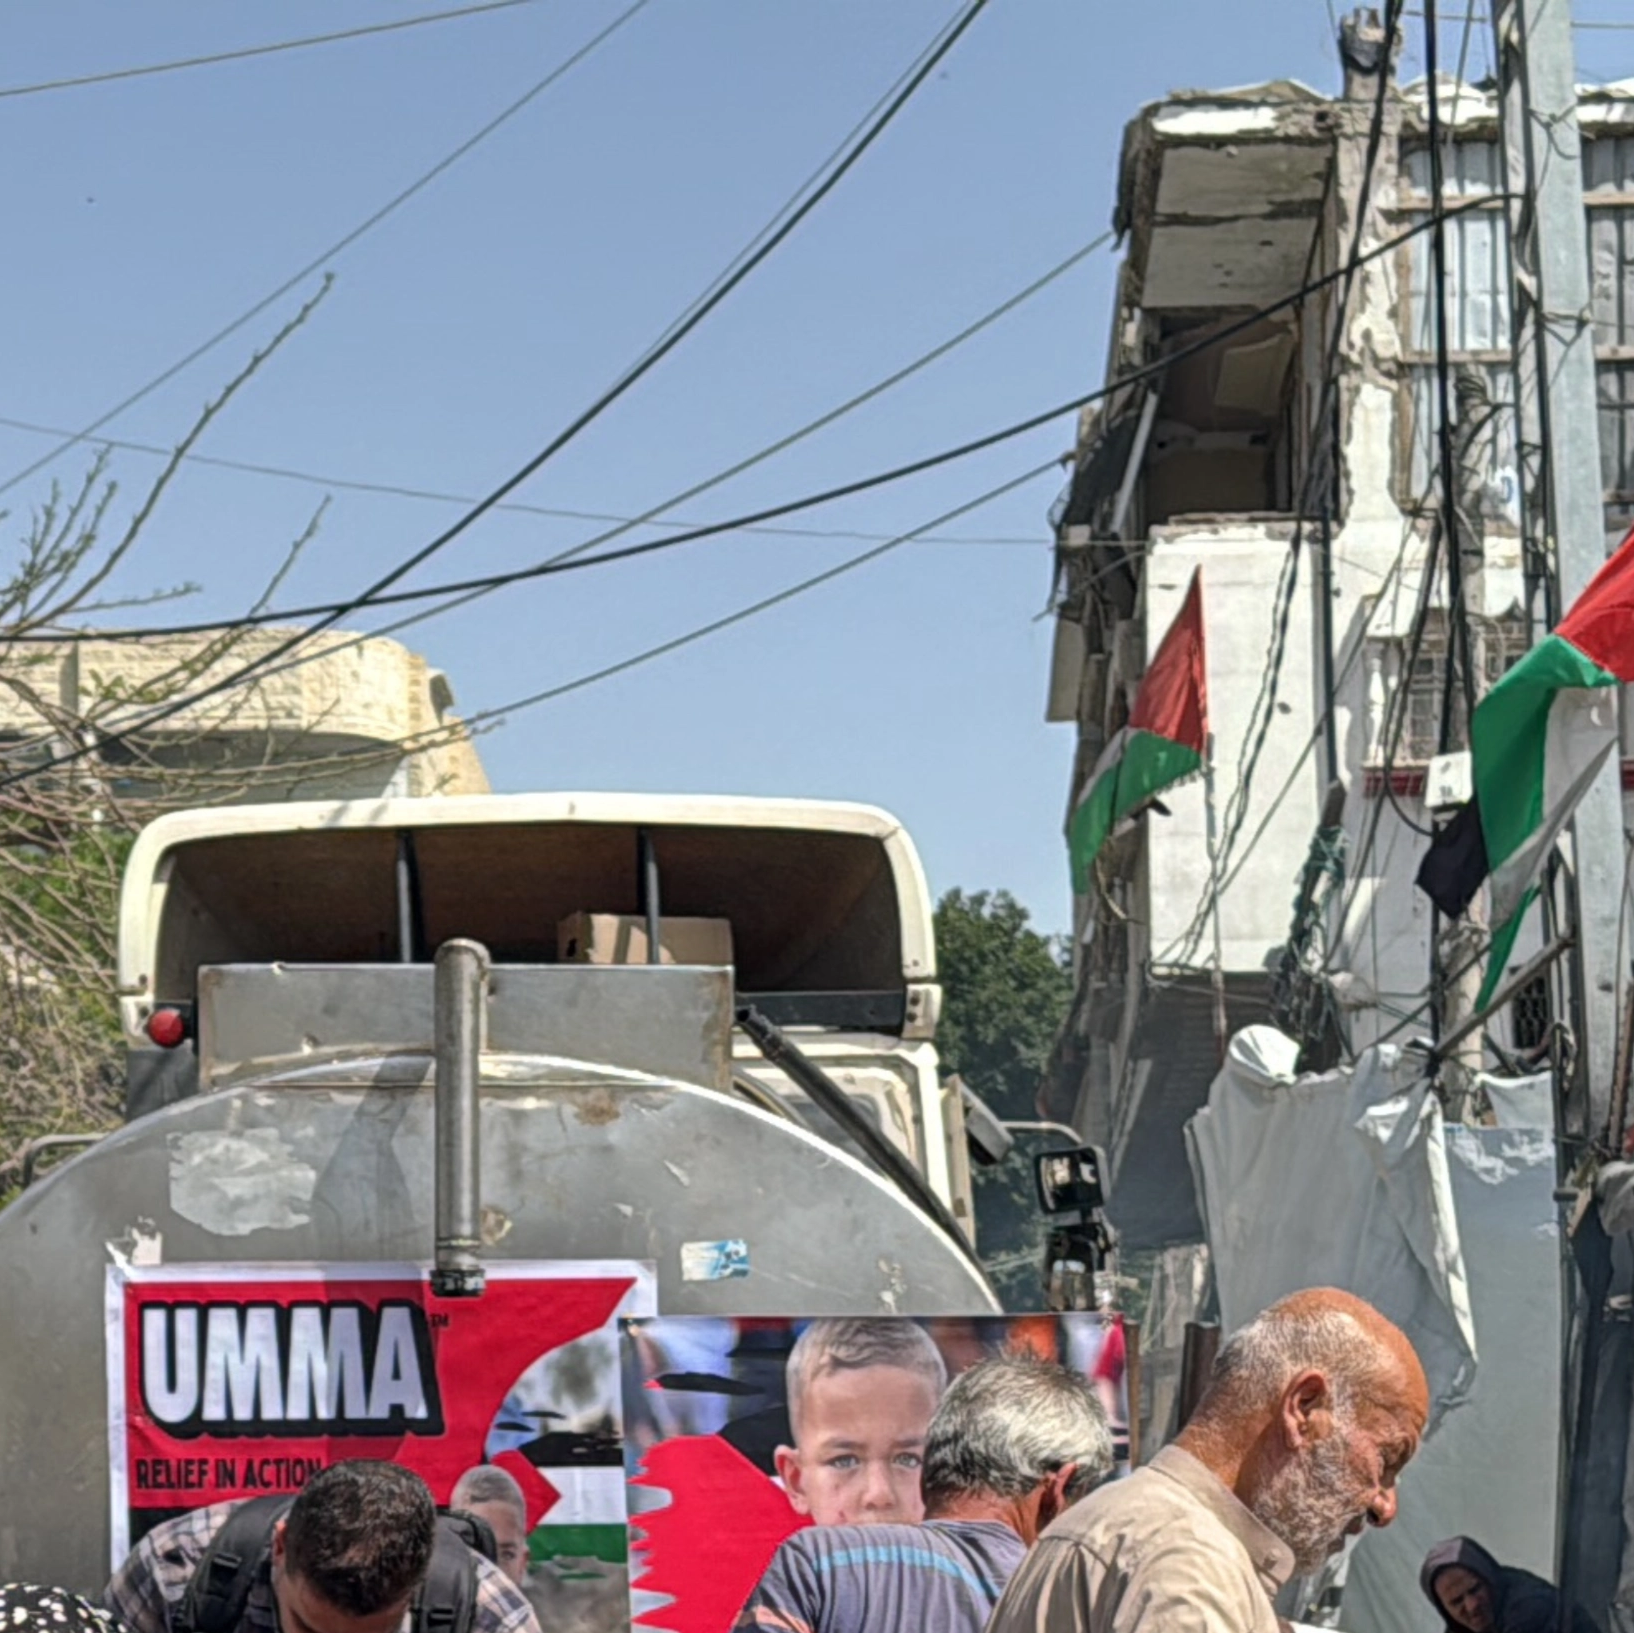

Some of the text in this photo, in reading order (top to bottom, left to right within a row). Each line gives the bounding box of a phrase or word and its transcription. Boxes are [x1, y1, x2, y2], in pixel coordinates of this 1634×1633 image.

[141, 1305, 430, 1424] UMMA
[135, 1458, 209, 1489] RELIEF
[216, 1458, 237, 1489] IN
